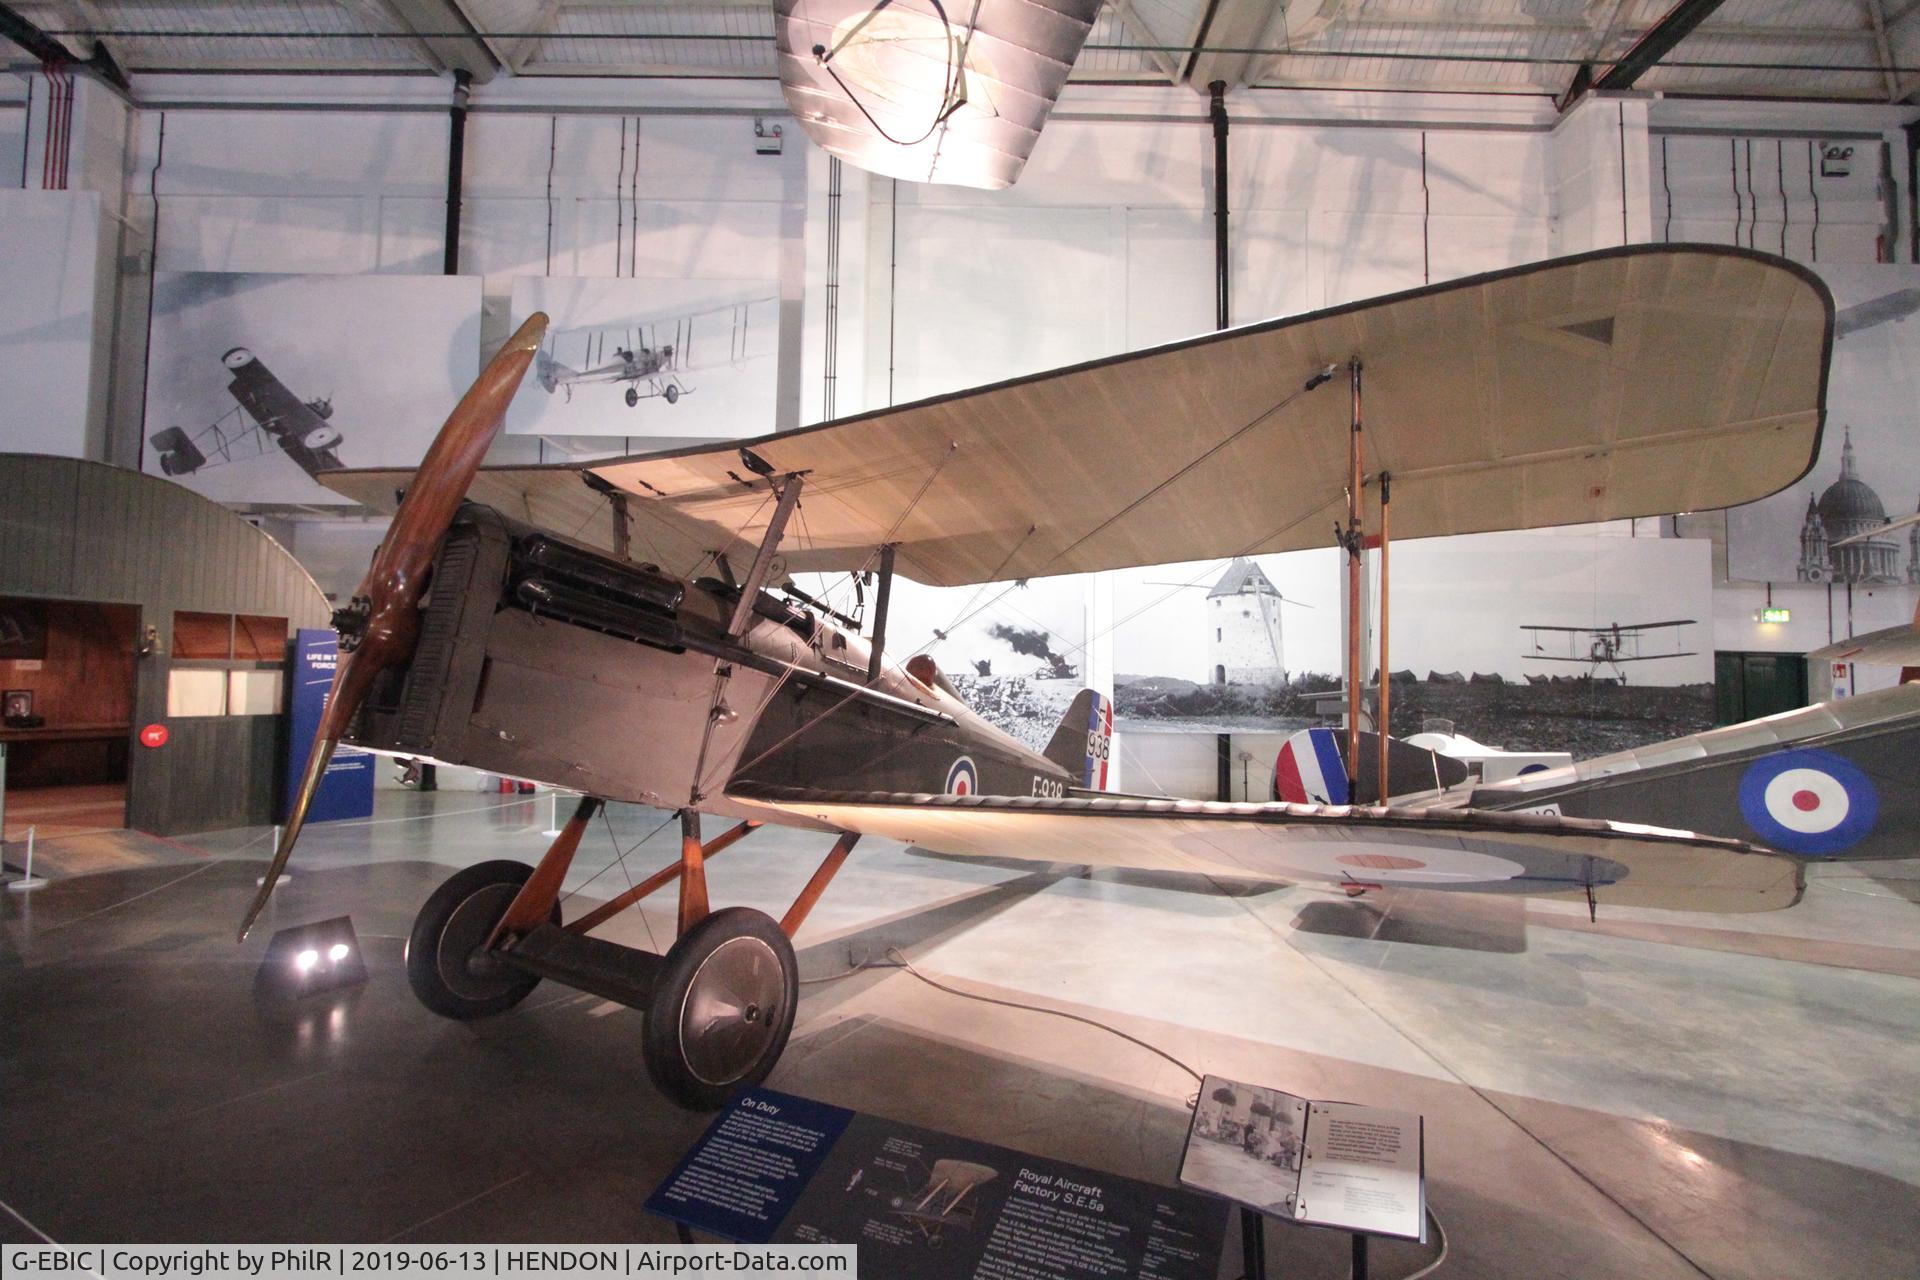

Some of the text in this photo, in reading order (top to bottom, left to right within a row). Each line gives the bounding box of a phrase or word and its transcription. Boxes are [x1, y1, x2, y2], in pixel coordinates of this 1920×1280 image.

[1088, 732, 1109, 760] 938
[741, 1097, 780, 1115] On Duty
[1013, 1180, 1060, 1201] Factory
[1063, 1192, 1104, 1212] S.E.5a
[1019, 1168, 1102, 1198] Royal Aircraft
